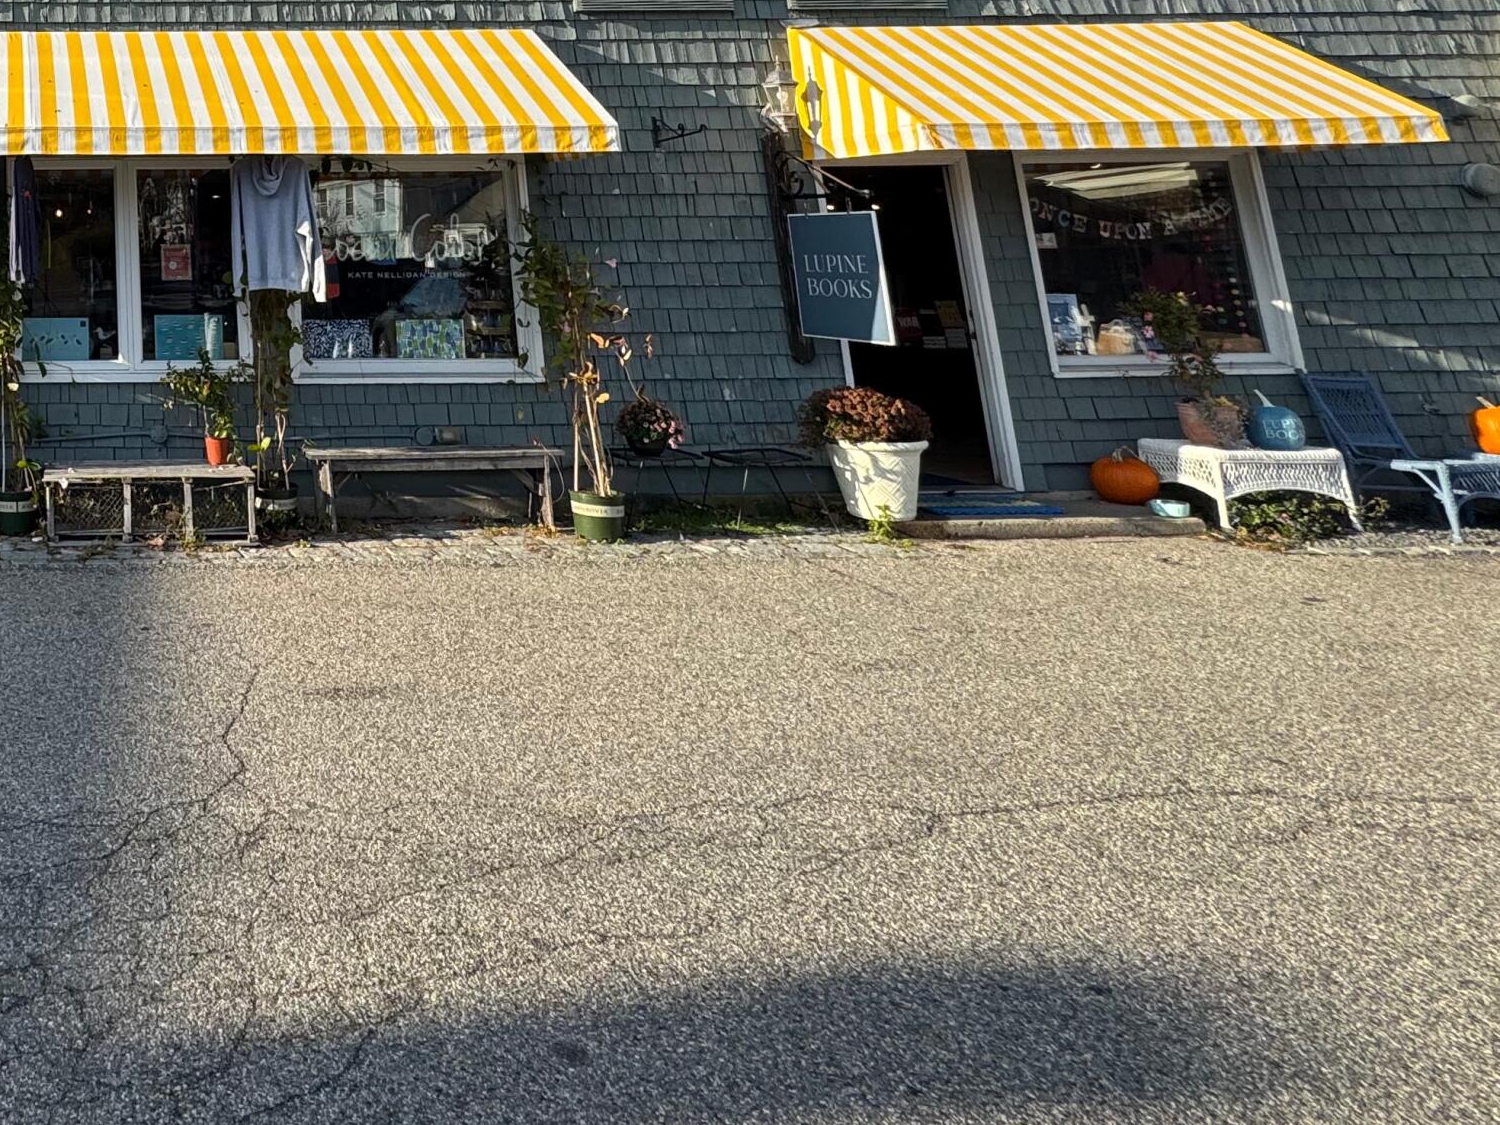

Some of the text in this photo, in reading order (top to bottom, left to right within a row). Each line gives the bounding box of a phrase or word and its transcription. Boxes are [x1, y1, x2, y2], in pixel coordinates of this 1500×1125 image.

[803, 254, 869, 274] LUPINE
[347, 271, 373, 279] KATE
[377, 271, 426, 279] NELLIGAN
[807, 278, 873, 299] BOOKS
